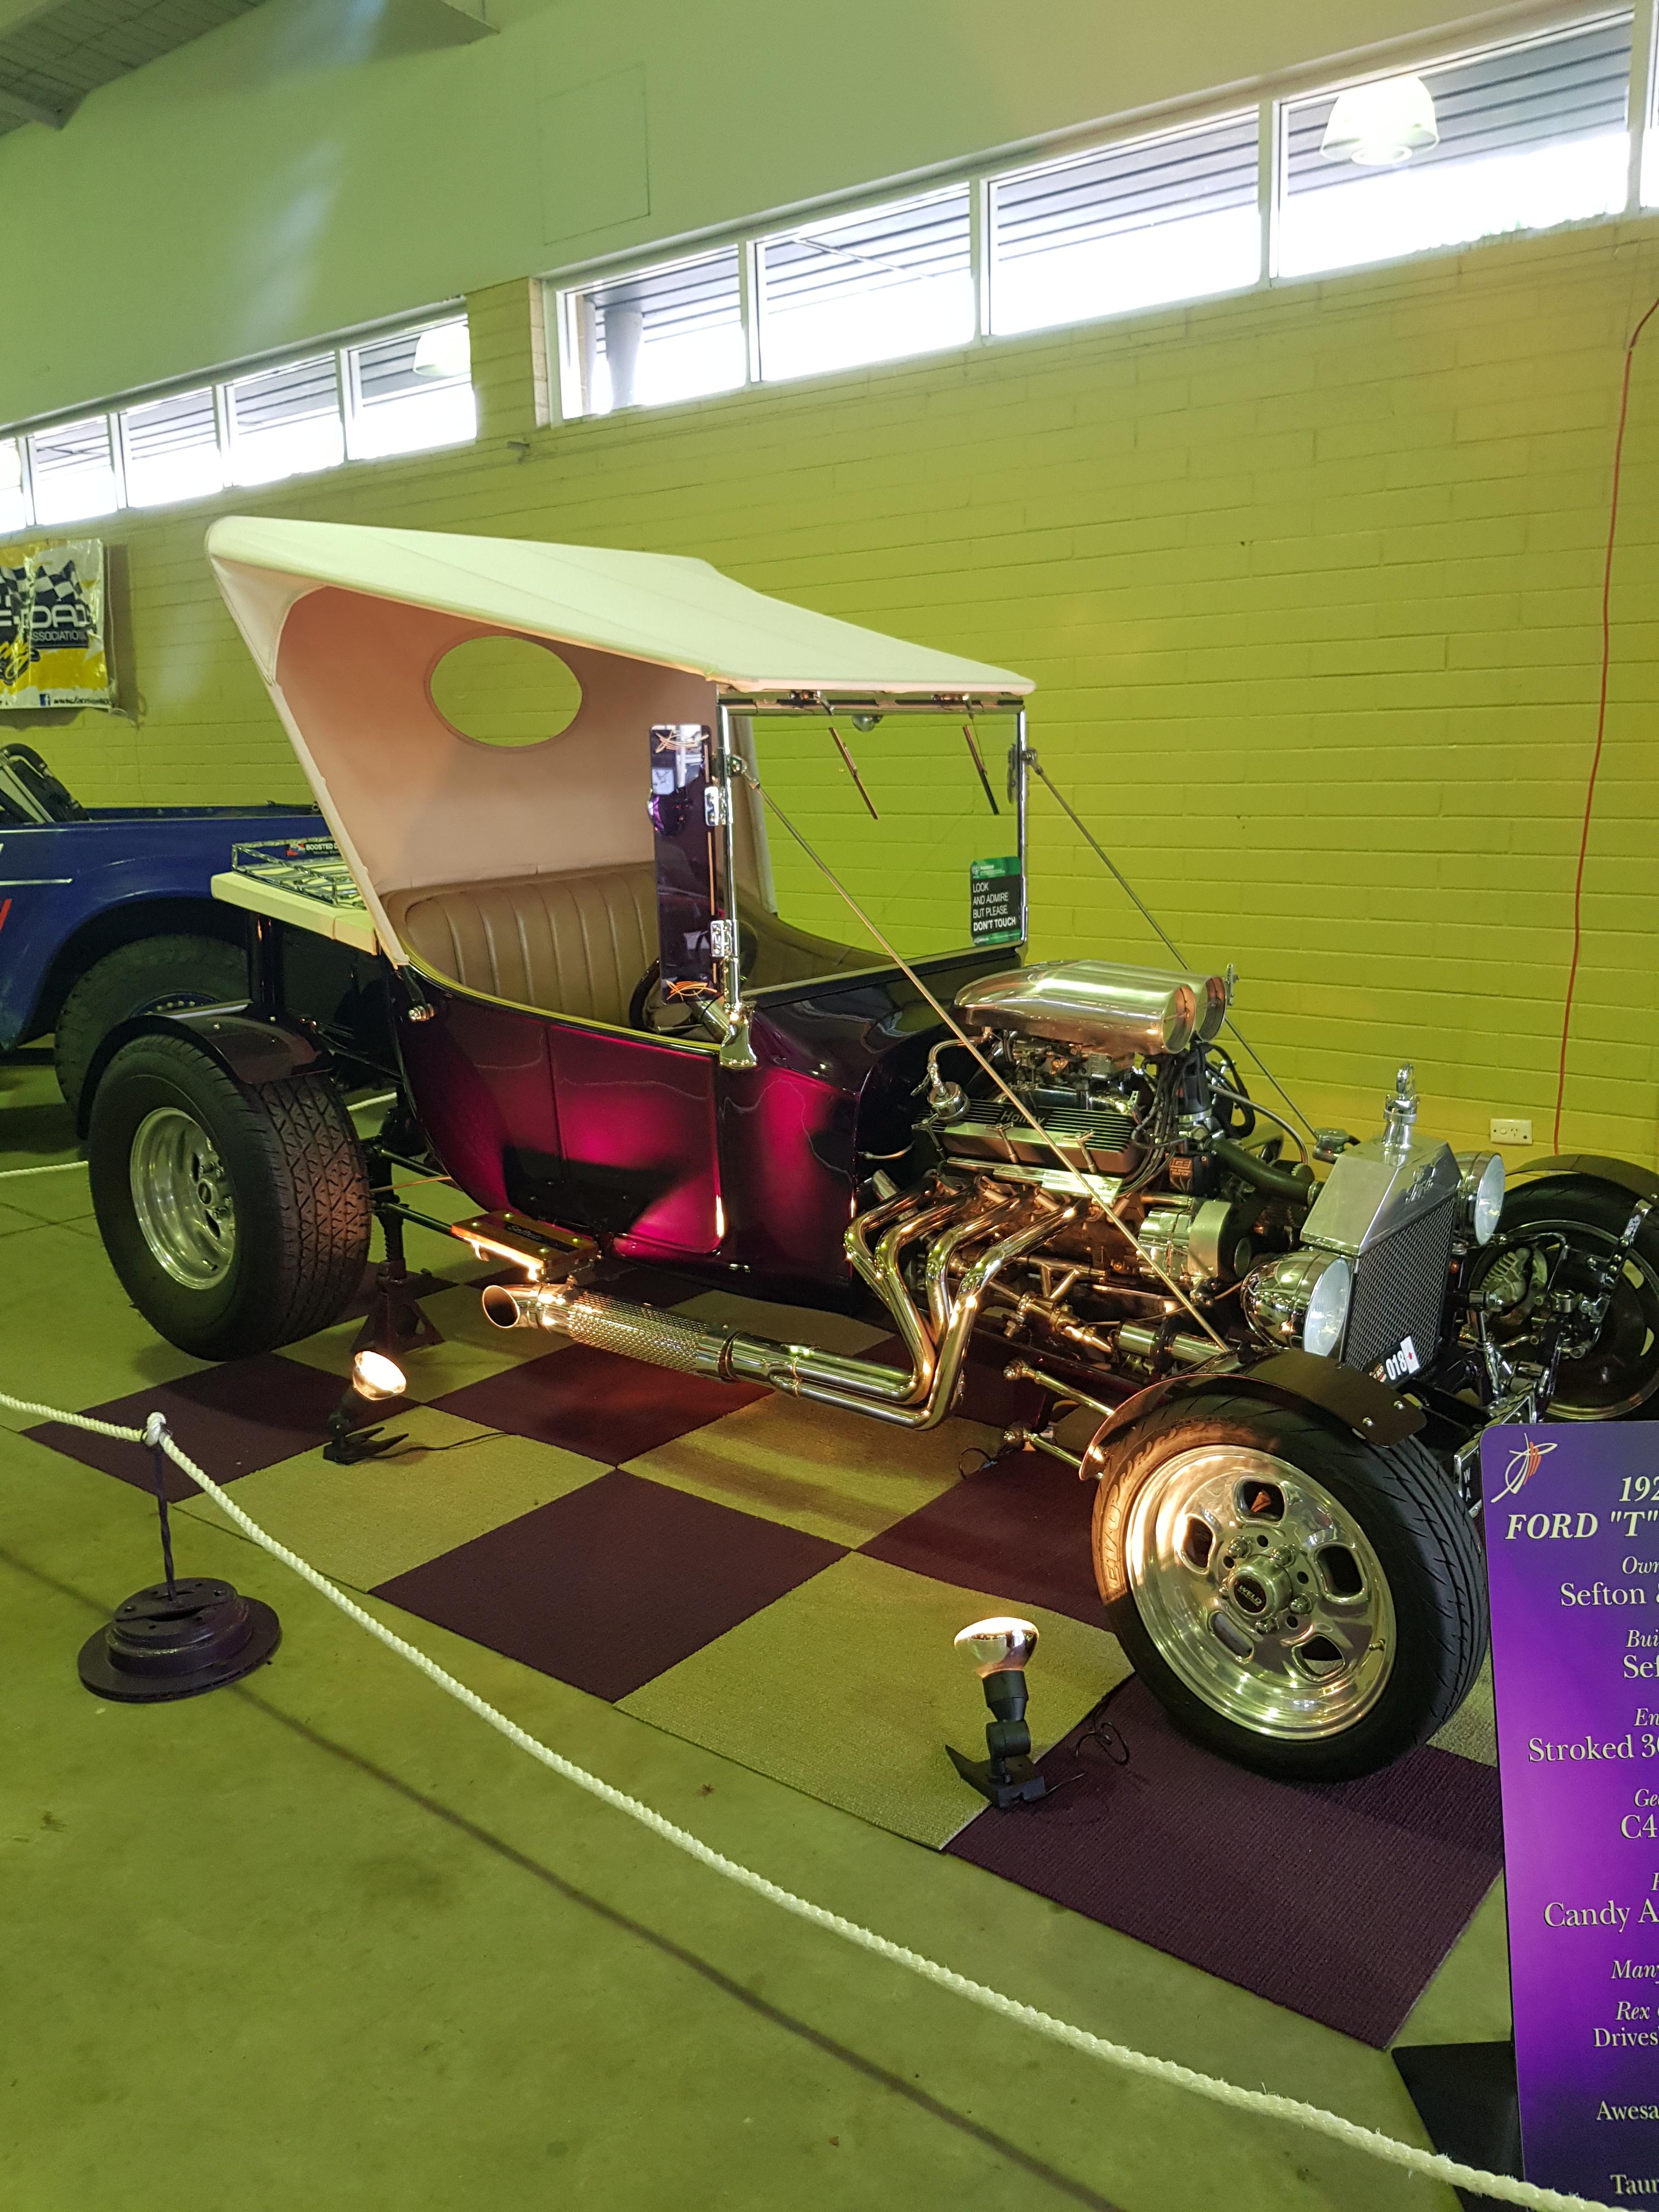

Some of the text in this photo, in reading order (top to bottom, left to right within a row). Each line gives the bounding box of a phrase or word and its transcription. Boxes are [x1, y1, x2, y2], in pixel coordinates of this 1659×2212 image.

[973, 882, 989, 893] LOOK
[973, 892, 1009, 906] AND ADMIRE
[973, 905, 1008, 919] BUT PLEASE
[973, 916, 1016, 932] DON'T TOUCH
[1386, 1350, 1408, 1380] 018
[1505, 1513, 1598, 1539] FORD
[1561, 1582, 1647, 1606] Sefton
[1528, 1734, 1635, 1762] Stroked
[1621, 1813, 1658, 1839] C4
[1544, 1900, 1631, 1933] Candy
[1615, 2001, 1650, 2021] Rex
[1593, 2027, 1659, 2047] Drives
